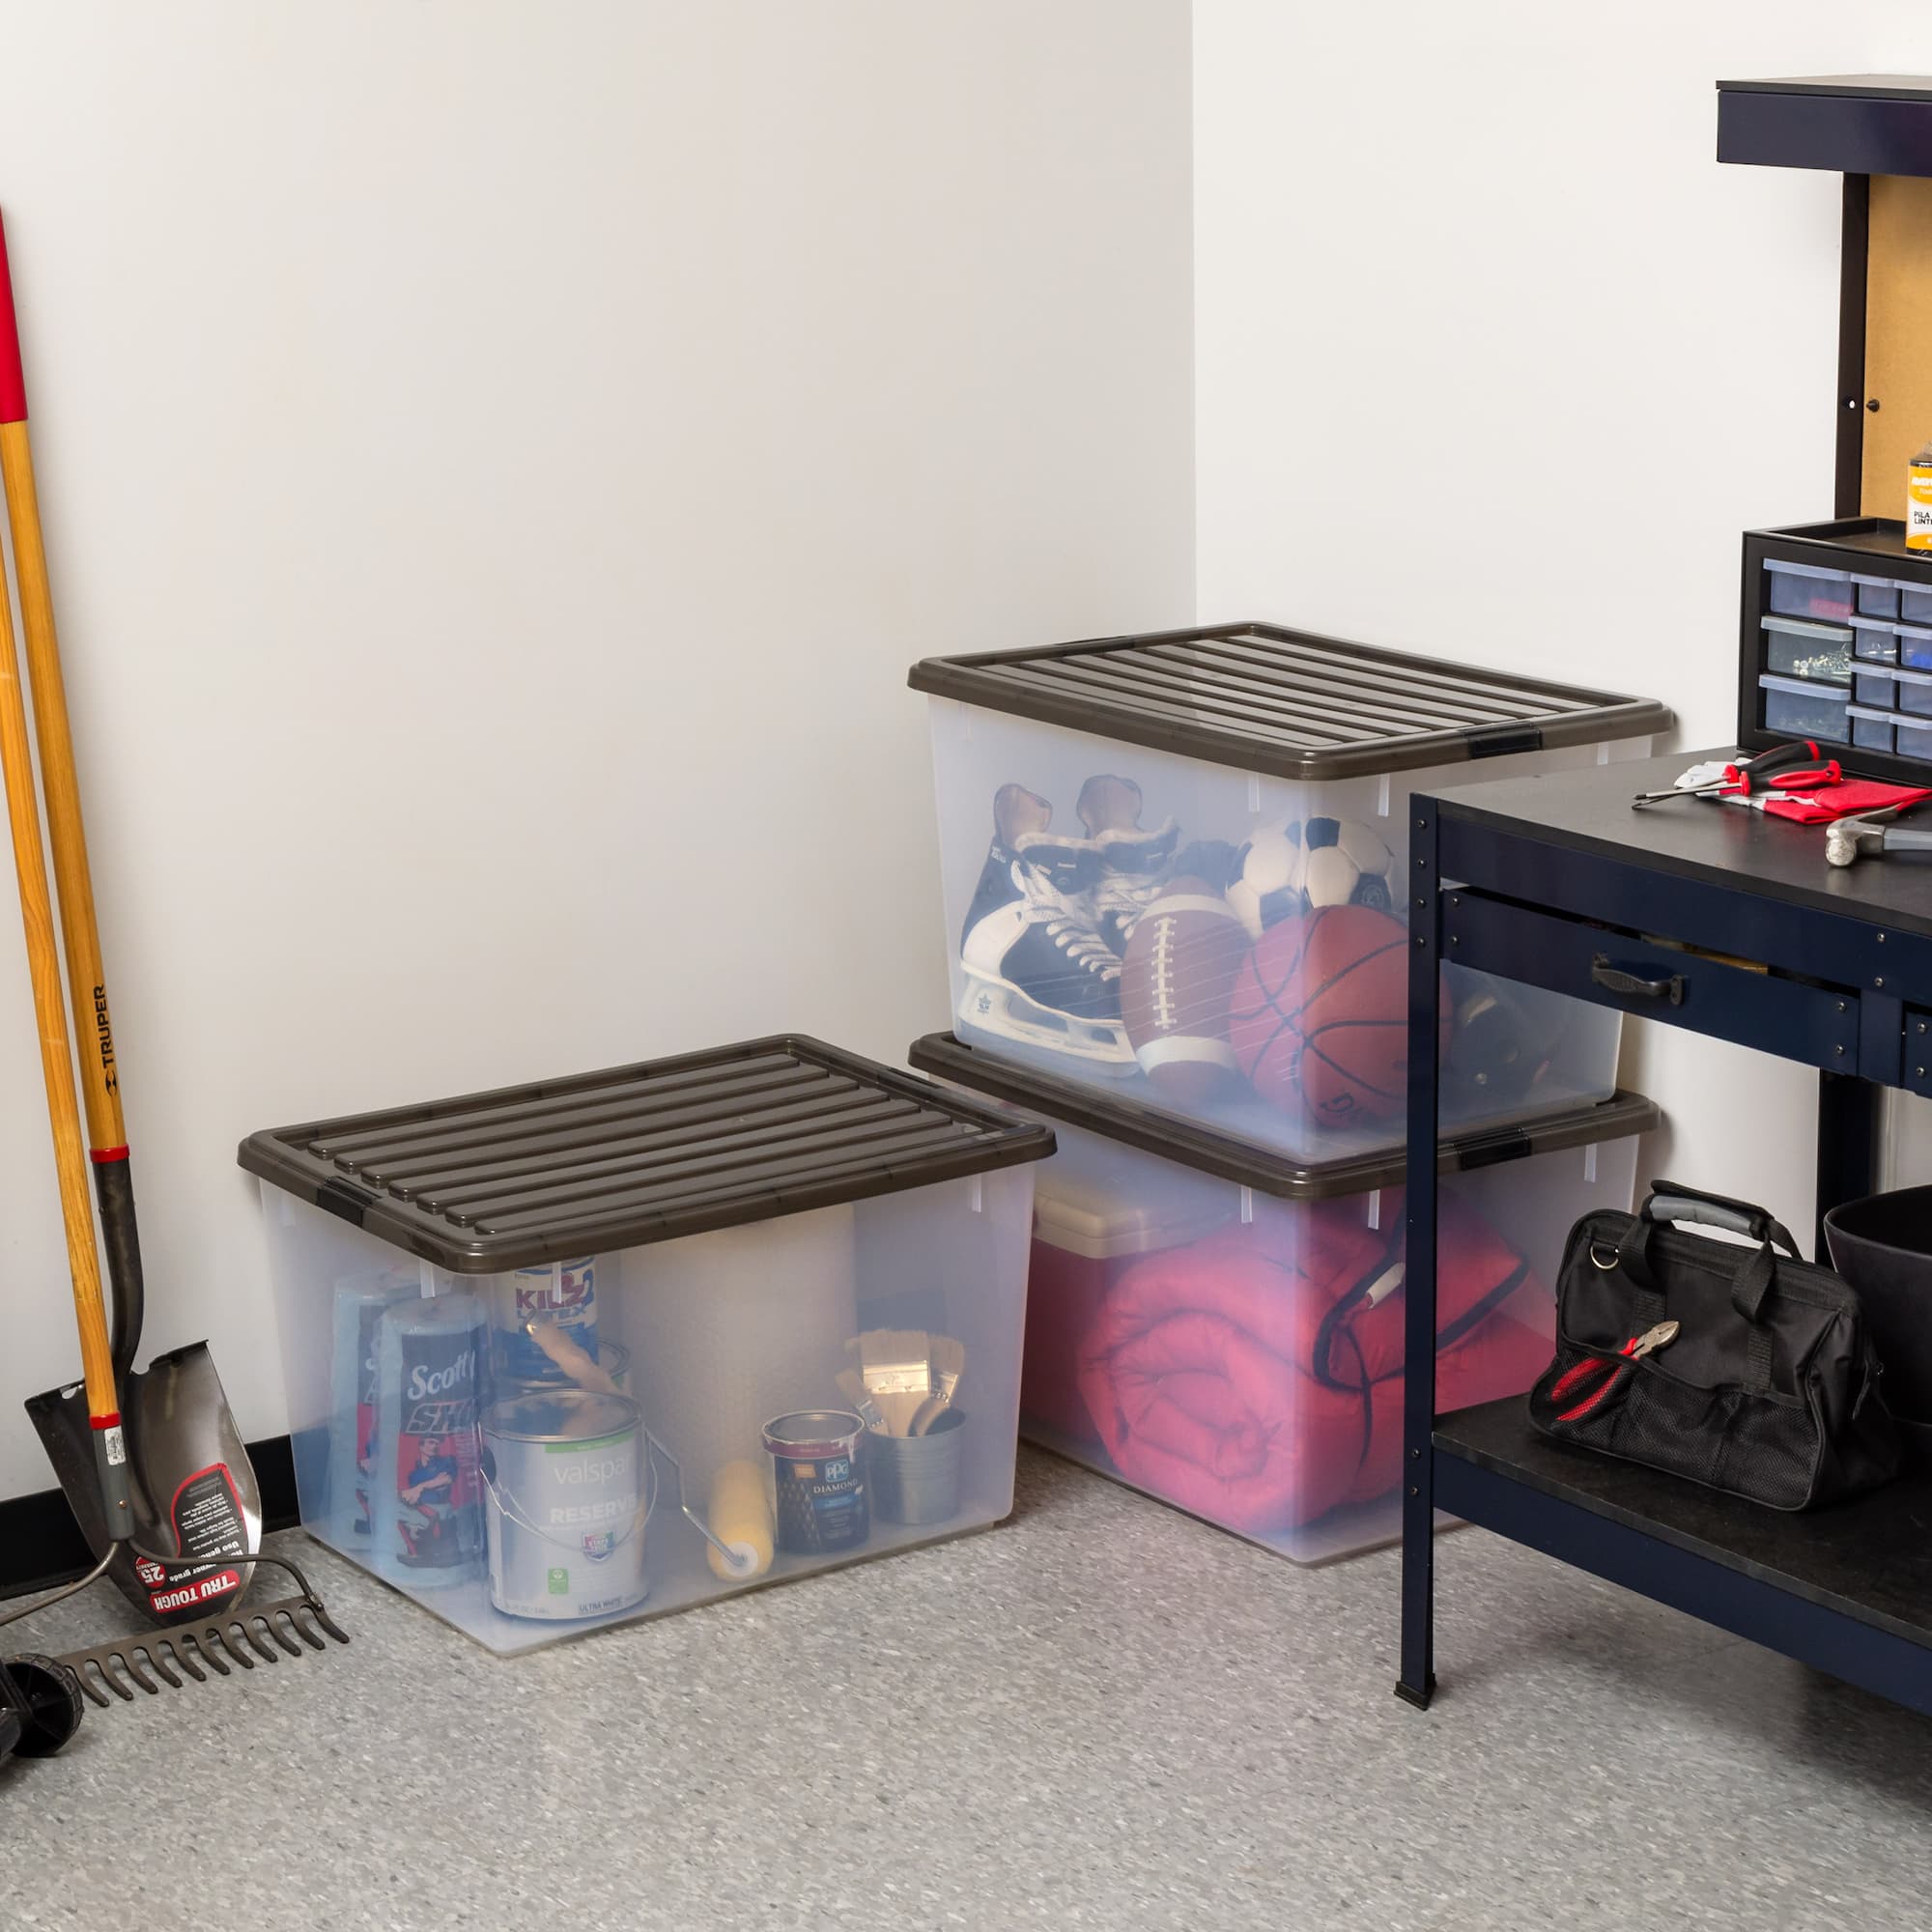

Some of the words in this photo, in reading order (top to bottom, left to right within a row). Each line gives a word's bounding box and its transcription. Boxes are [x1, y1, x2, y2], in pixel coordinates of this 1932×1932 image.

[94, 984, 114, 1068] TRUPER
[827, 1462, 848, 1479] PPG
[812, 1478, 859, 1494] DIAMOND
[140, 1566, 164, 1583] 25
[168, 1568, 191, 1582] grade
[200, 1575, 236, 1598] TRU
[154, 1587, 199, 1610] TOUGH
